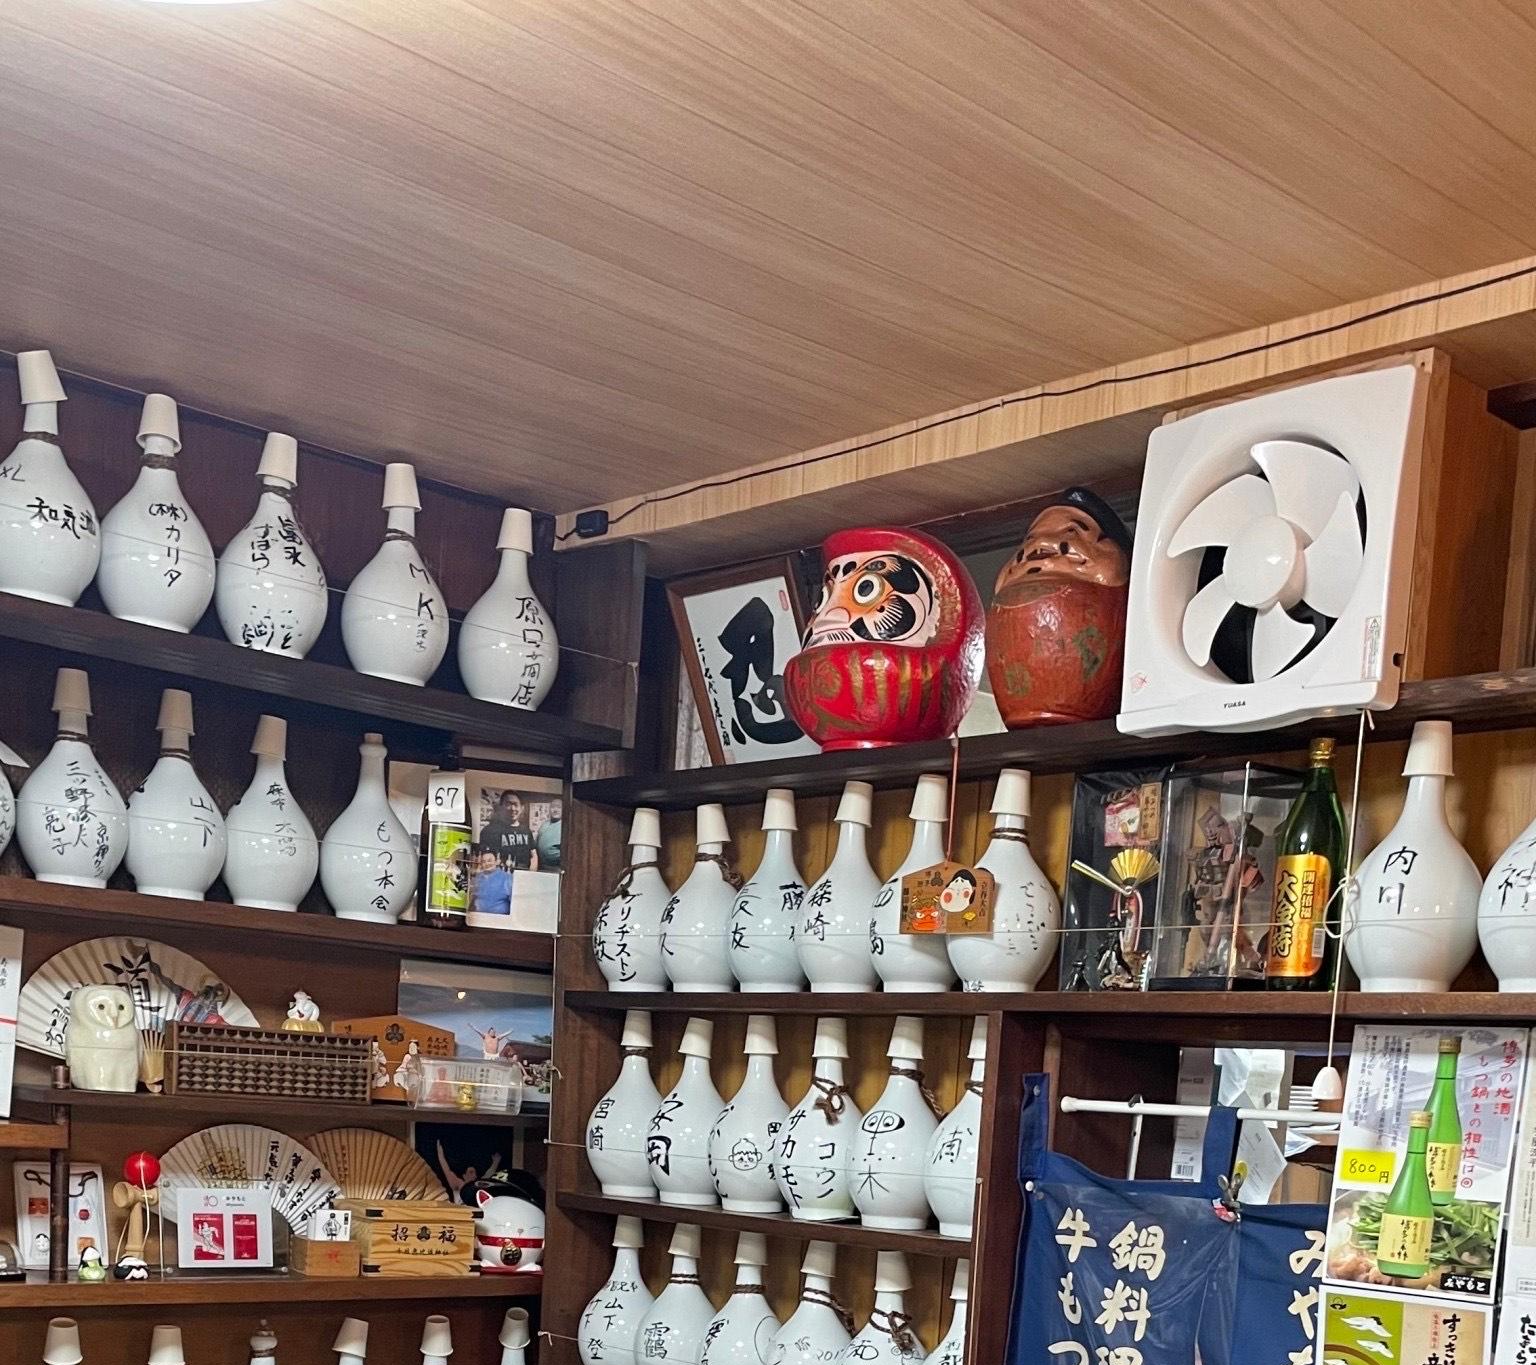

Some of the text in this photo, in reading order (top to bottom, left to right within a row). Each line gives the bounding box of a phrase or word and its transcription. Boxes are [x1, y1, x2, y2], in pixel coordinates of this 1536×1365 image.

[163, 525, 182, 587] カリタ
[1223, 700, 1246, 709] YUASA
[435, 787, 459, 808] 67
[189, 797, 217, 847] 山下
[501, 832, 529, 847] ARMY
[371, 820, 395, 912] もつ本会
[780, 1109, 807, 1210] サカモト
[1349, 1158, 1390, 1184] 800円
